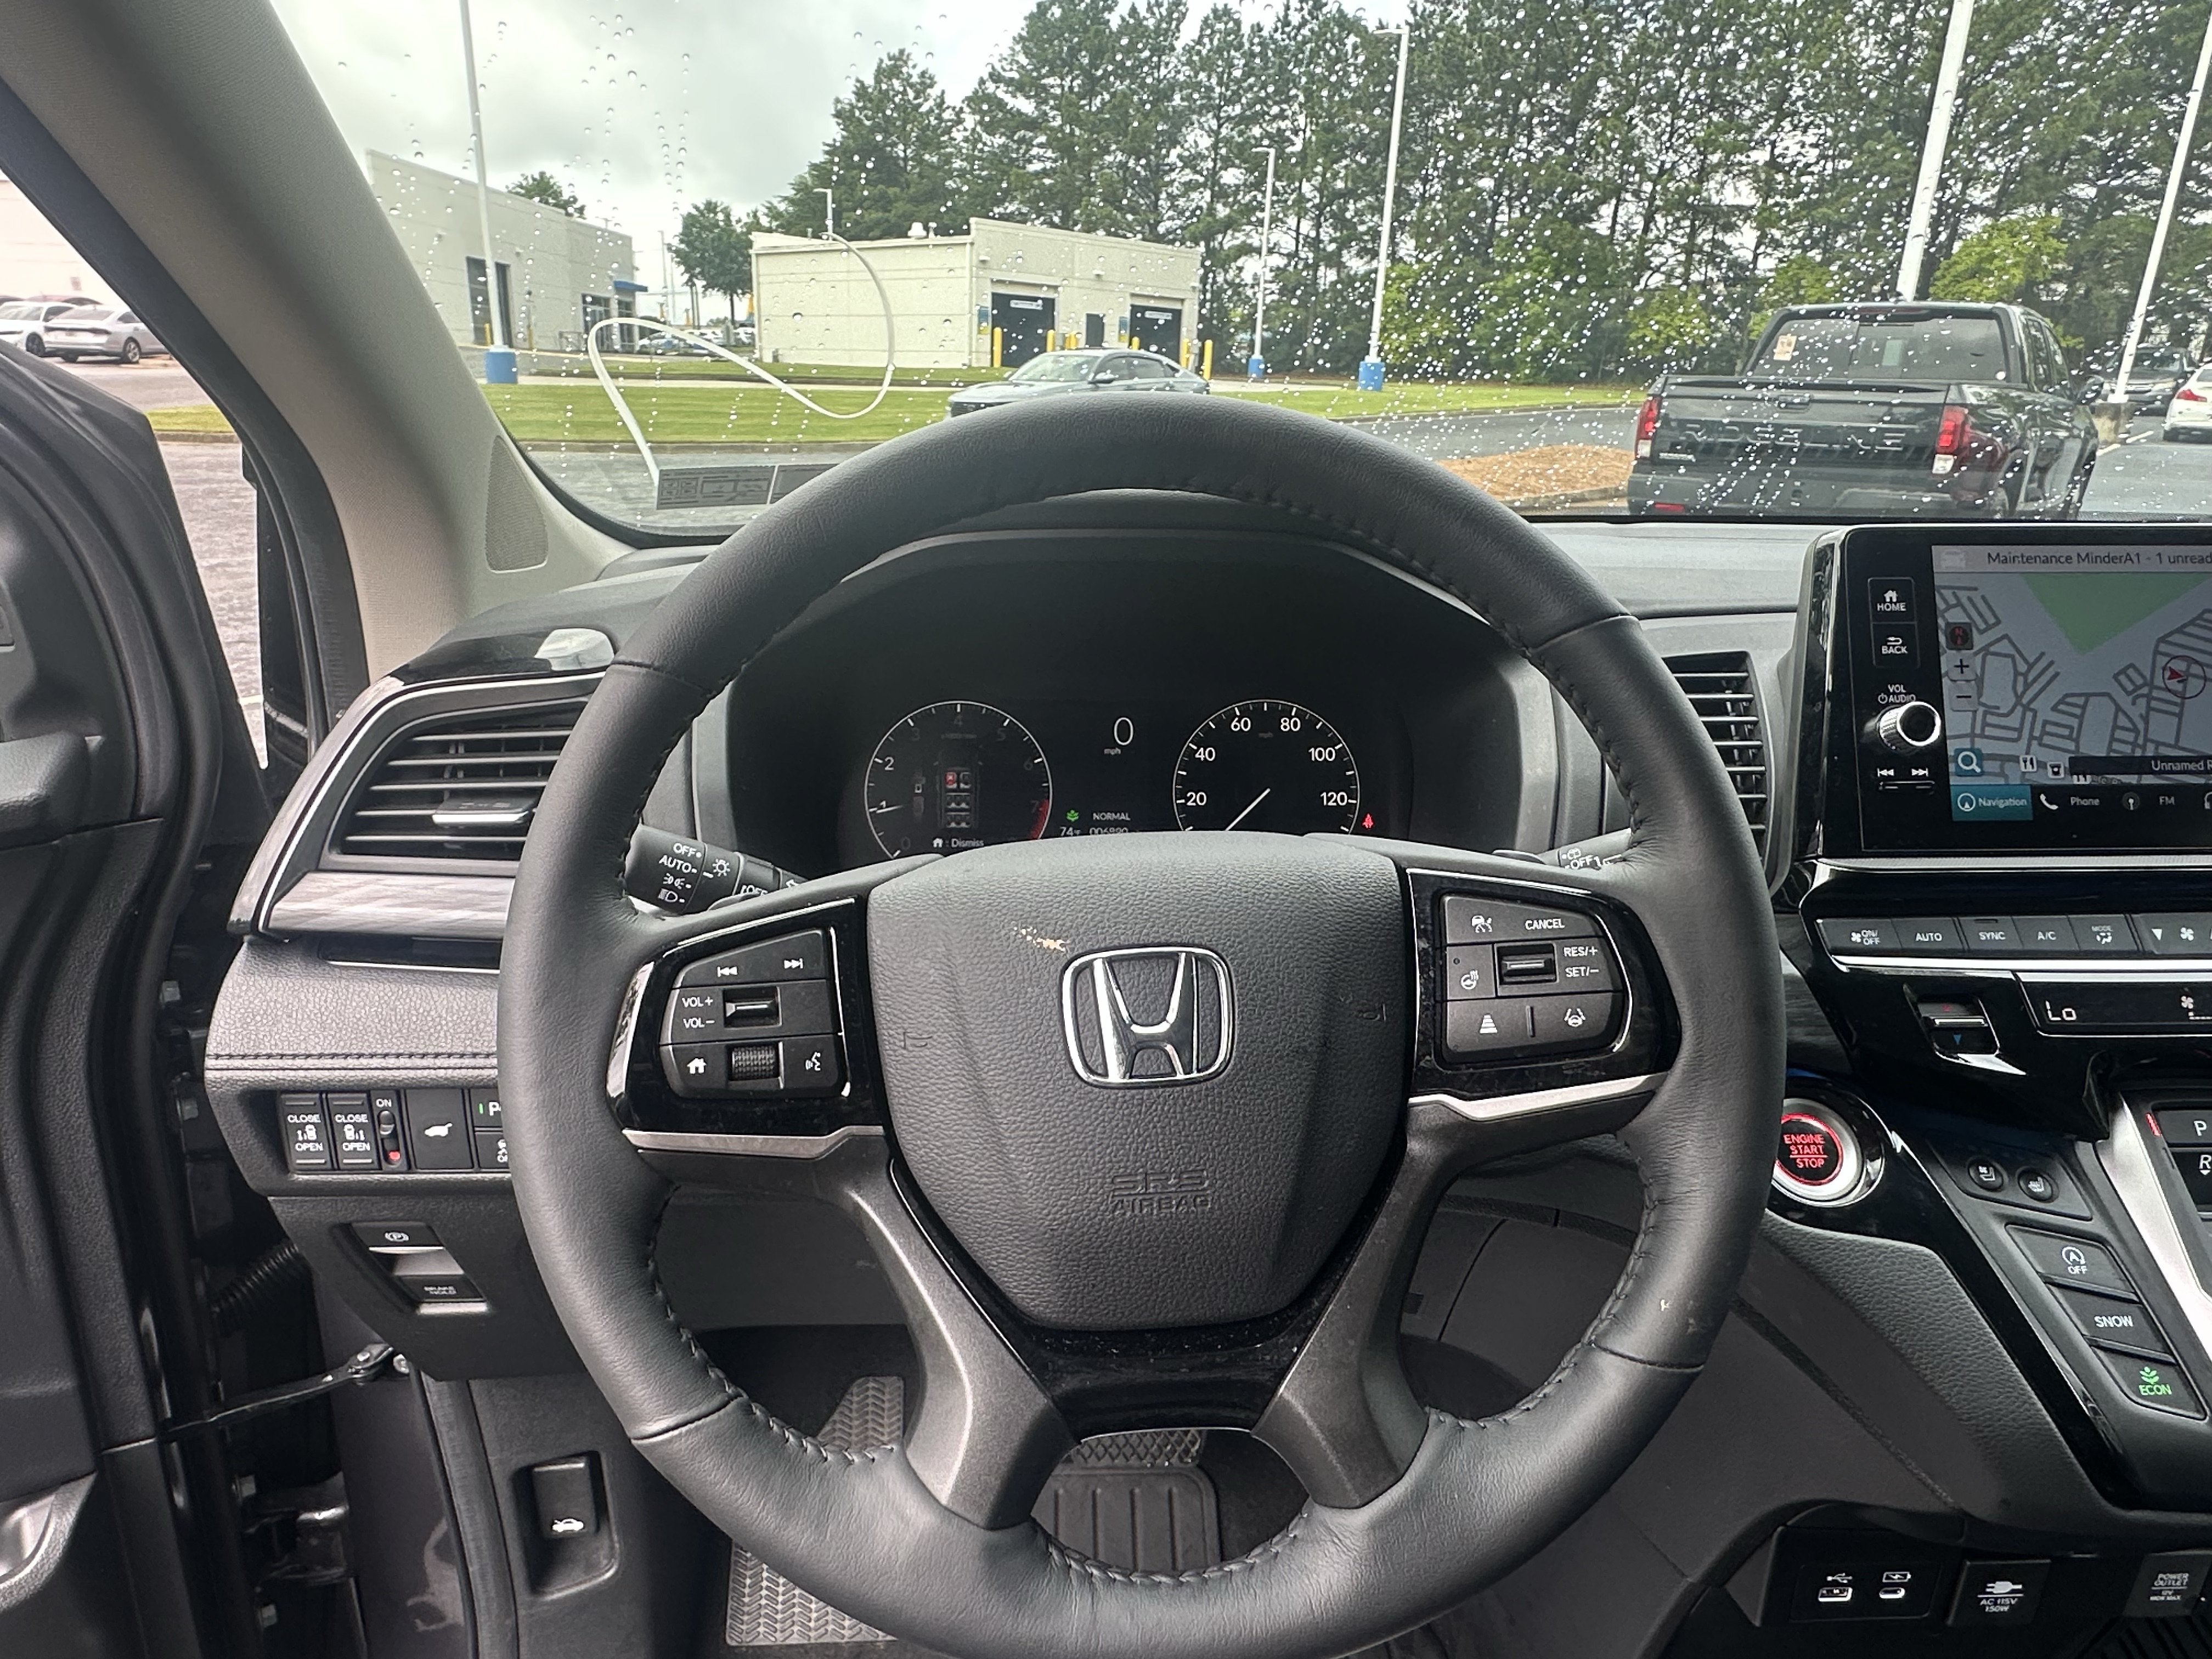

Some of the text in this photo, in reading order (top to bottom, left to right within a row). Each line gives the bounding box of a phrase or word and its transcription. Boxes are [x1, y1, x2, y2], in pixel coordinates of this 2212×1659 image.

[1987, 551, 2073, 565] Maintenance
[1877, 602, 1907, 612] HOME
[1882, 645, 1908, 654] BACK
[1888, 684, 1906, 693] VOL
[1888, 693, 1916, 703] AUDIO
[1231, 718, 1251, 731] 60
[1280, 718, 1301, 731] 80
[1114, 716, 1134, 746] 0
[1195, 748, 1216, 761] 40
[1308, 748, 1336, 761] 100
[884, 757, 894, 770] 2
[2151, 760, 2203, 770] Unnamed
[1186, 792, 1207, 806] 20
[1321, 792, 1347, 806] 120
[1978, 797, 2028, 809] Navigation
[2070, 796, 2100, 806] Phone
[2159, 797, 2175, 805] FM
[1093, 812, 1131, 821] NORMAL
[951, 838, 984, 848] Dismiss
[673, 843, 696, 857] OFF
[659, 855, 691, 873] AUTO
[1571, 855, 1593, 870] OFF
[1525, 918, 1565, 930] CANCEL
[1915, 932, 1942, 942] AUTO
[1979, 932, 2006, 940] SYNC
[2037, 932, 2056, 940] A/C
[1564, 946, 1598, 957] RES/+
[376, 1099, 392, 1107] ON
[287, 1114, 321, 1123] CLOSE
[335, 1114, 368, 1123] CLOSE
[2194, 1120, 2207, 1137] P
[1783, 1133, 1825, 1144] ENGINE
[295, 1142, 324, 1151] OPEN
[342, 1142, 370, 1151] OPEN
[1790, 1144, 1824, 1155] START
[1796, 1158, 1825, 1169] STOP
[2199, 1154, 2212, 1170] R
[2067, 1265, 2087, 1274] OFF
[2094, 1316, 2133, 1328] SNOW
[2139, 1384, 2172, 1395] ECON
